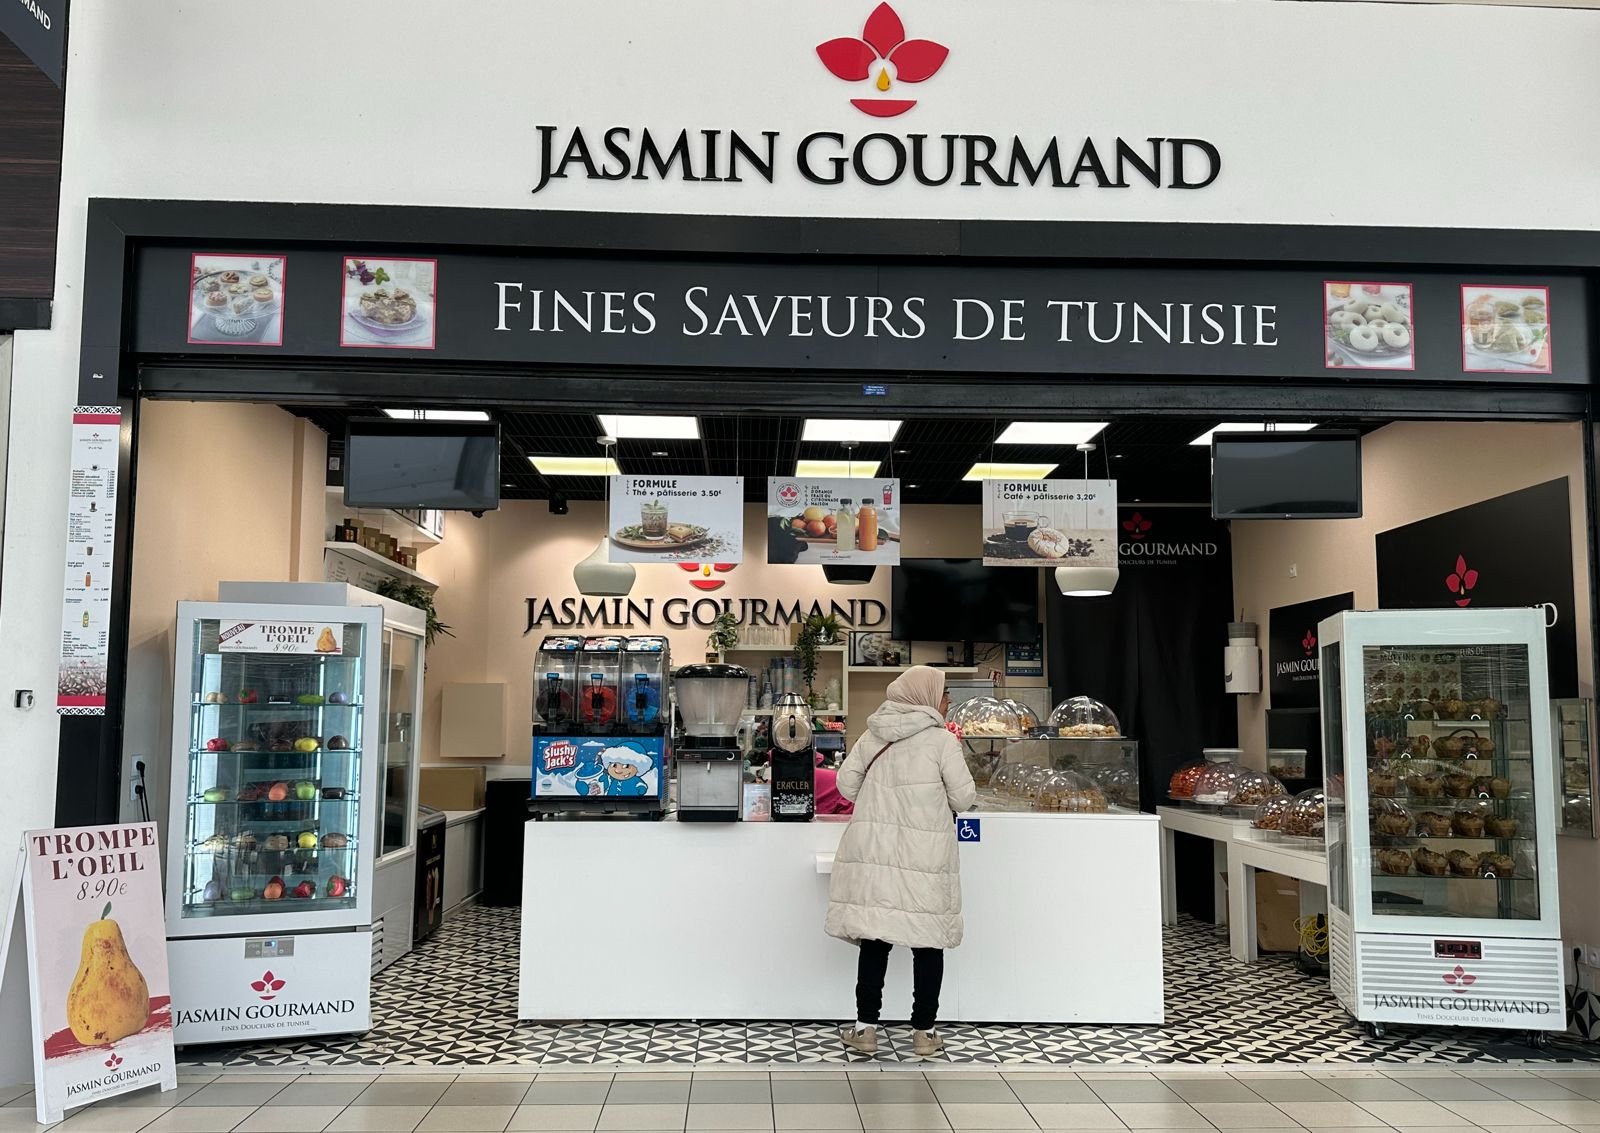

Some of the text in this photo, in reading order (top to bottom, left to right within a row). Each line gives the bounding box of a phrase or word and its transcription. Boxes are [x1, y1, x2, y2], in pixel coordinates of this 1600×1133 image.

[532, 125, 1222, 193] JASMIN GOURMAND
[494, 281, 1278, 347] FINES SAVEURS DE TUNISIE
[633, 480, 677, 488] FORMULE
[1003, 483, 1048, 492] FORMULE
[657, 489, 698, 498] pâtisserie
[1033, 493, 1074, 501] pâtisserie
[1118, 542, 1218, 556] GOURMAND
[523, 598, 887, 634] JASMIN GOURMAND
[221, 623, 246, 640] NOUVEAU
[260, 625, 315, 635] TROMPE
[266, 634, 308, 643] L'OEIL
[1276, 660, 1300, 677] JASMIN
[544, 745, 577, 759] Slushy
[546, 755, 574, 769] Jack's
[776, 781, 810, 790] ERACLEA
[33, 826, 156, 857] TROMPE
[51, 851, 145, 881] L'OEIL
[76, 877, 128, 901] 8.90€
[1373, 993, 1551, 1015] JASMIN GOURMAND
[175, 999, 355, 1028] JASMIN GOURMAND
[66, 1078, 102, 1098] JASMIN
[103, 1062, 161, 1085] GOURMAND
